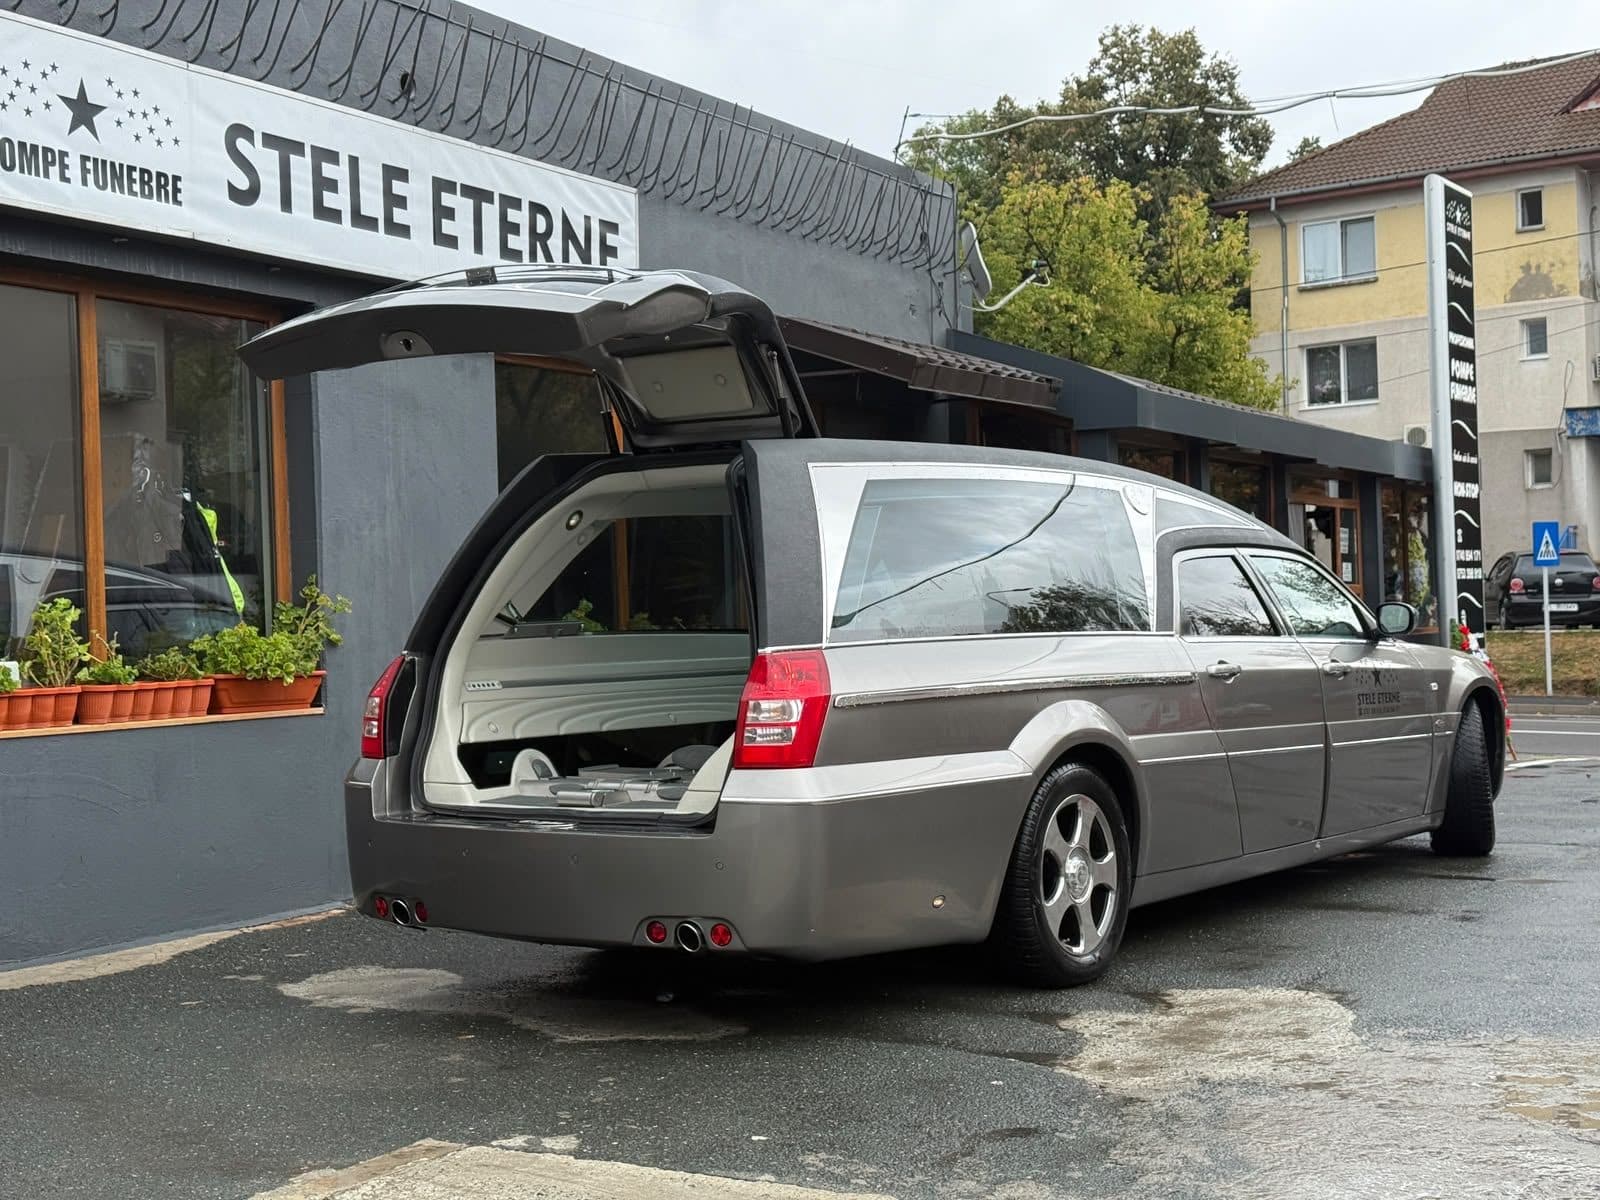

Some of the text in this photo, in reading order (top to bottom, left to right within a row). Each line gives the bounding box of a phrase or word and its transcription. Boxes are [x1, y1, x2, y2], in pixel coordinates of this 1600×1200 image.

[79, 153, 183, 207] FUNEBRE
[224, 122, 411, 240] STELE
[1451, 358, 1474, 381] POMPE
[1453, 481, 1479, 499] NON-STOP
[1357, 692, 1376, 706] STELE
